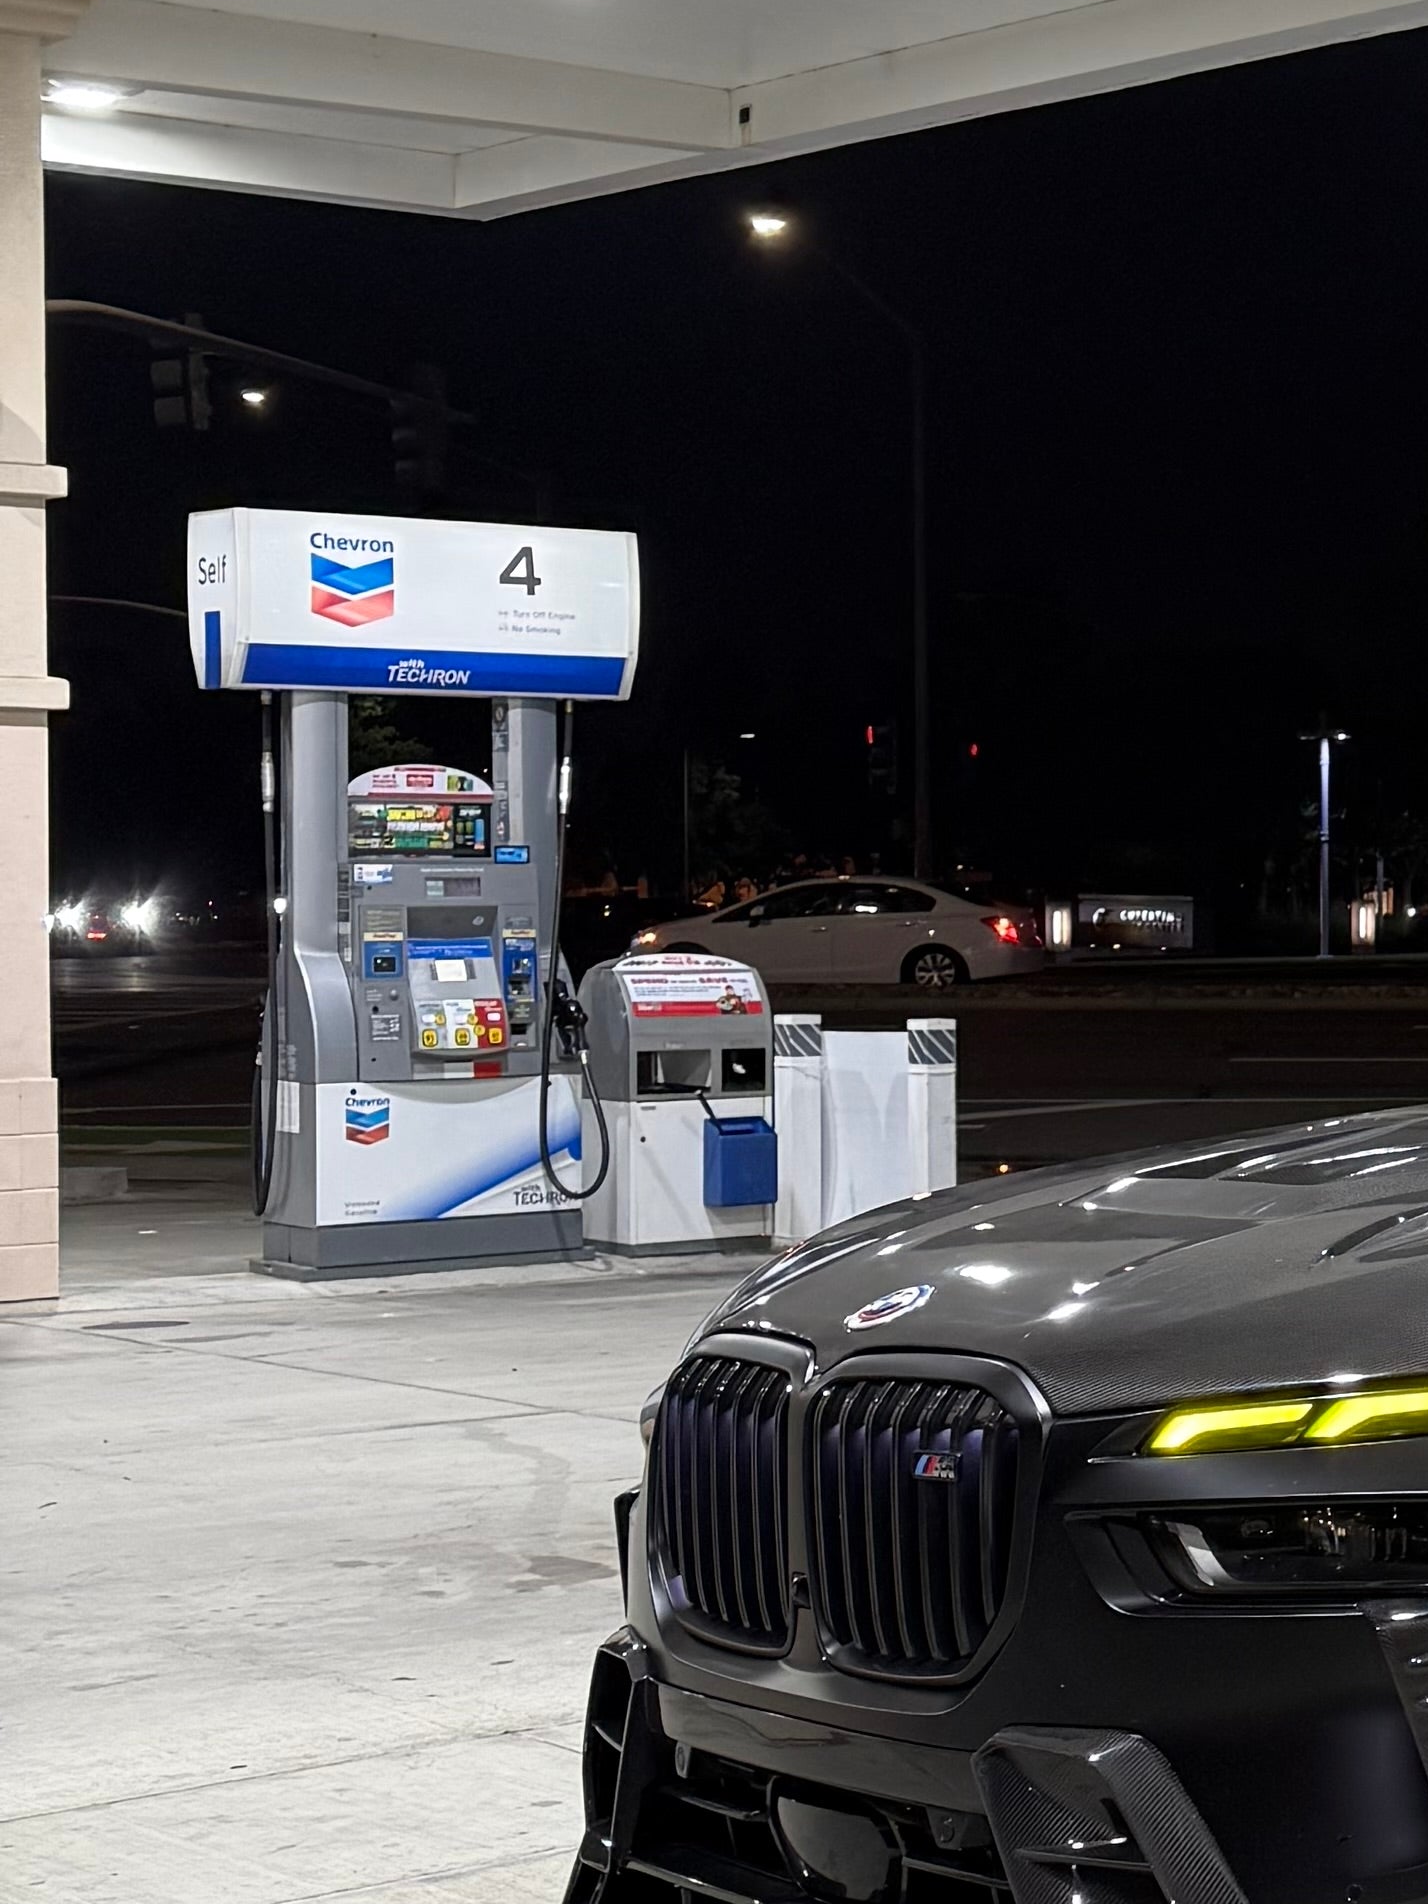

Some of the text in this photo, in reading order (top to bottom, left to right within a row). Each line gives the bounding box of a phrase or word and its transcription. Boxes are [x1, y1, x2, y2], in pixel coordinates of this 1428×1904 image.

[309, 532, 395, 553] Chevron
[197, 555, 227, 585] Self
[499, 546, 542, 596] 4
[387, 665, 471, 686] TECHRON
[345, 1097, 390, 1106] Chevron
[513, 1191, 577, 1205] TECHRO
